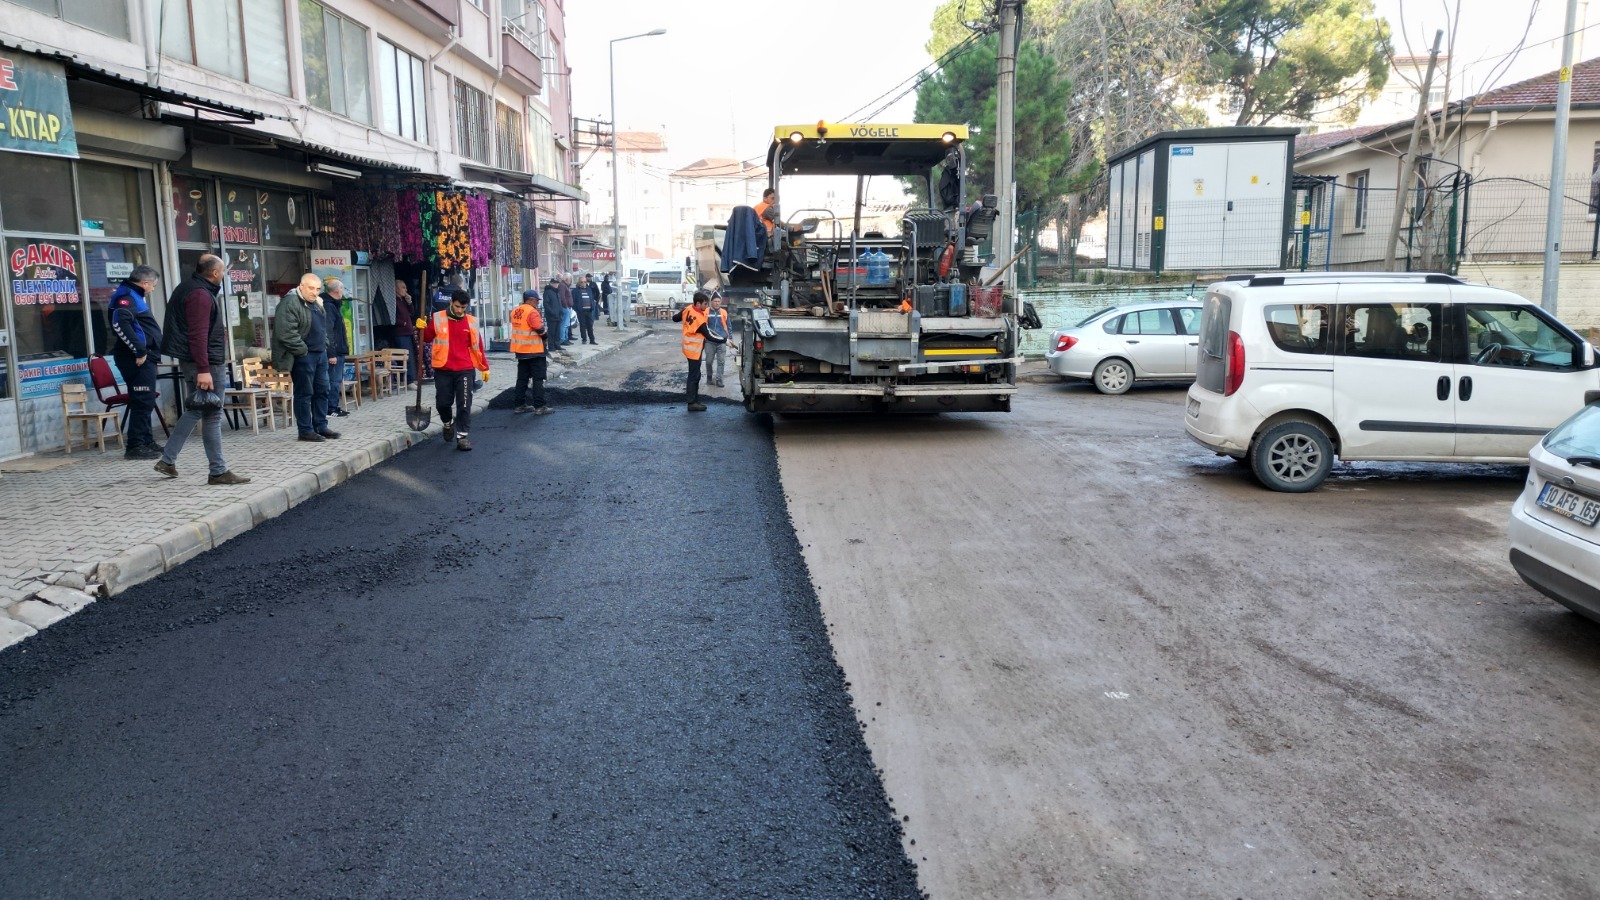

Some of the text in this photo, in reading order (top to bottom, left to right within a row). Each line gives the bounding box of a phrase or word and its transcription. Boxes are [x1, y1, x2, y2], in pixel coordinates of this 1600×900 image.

[8, 100, 60, 142] KİTAP
[849, 125, 899, 137] VÖGELE
[11, 244, 77, 277] ÇAKIR
[314, 256, 344, 265] sarıkız
[13, 277, 77, 294] ELEKTRONİK
[14, 294, 37, 305] 0507
[1545, 486, 1559, 504] 10
[1556, 491, 1580, 513] AFG
[1579, 500, 1600, 521] 165
